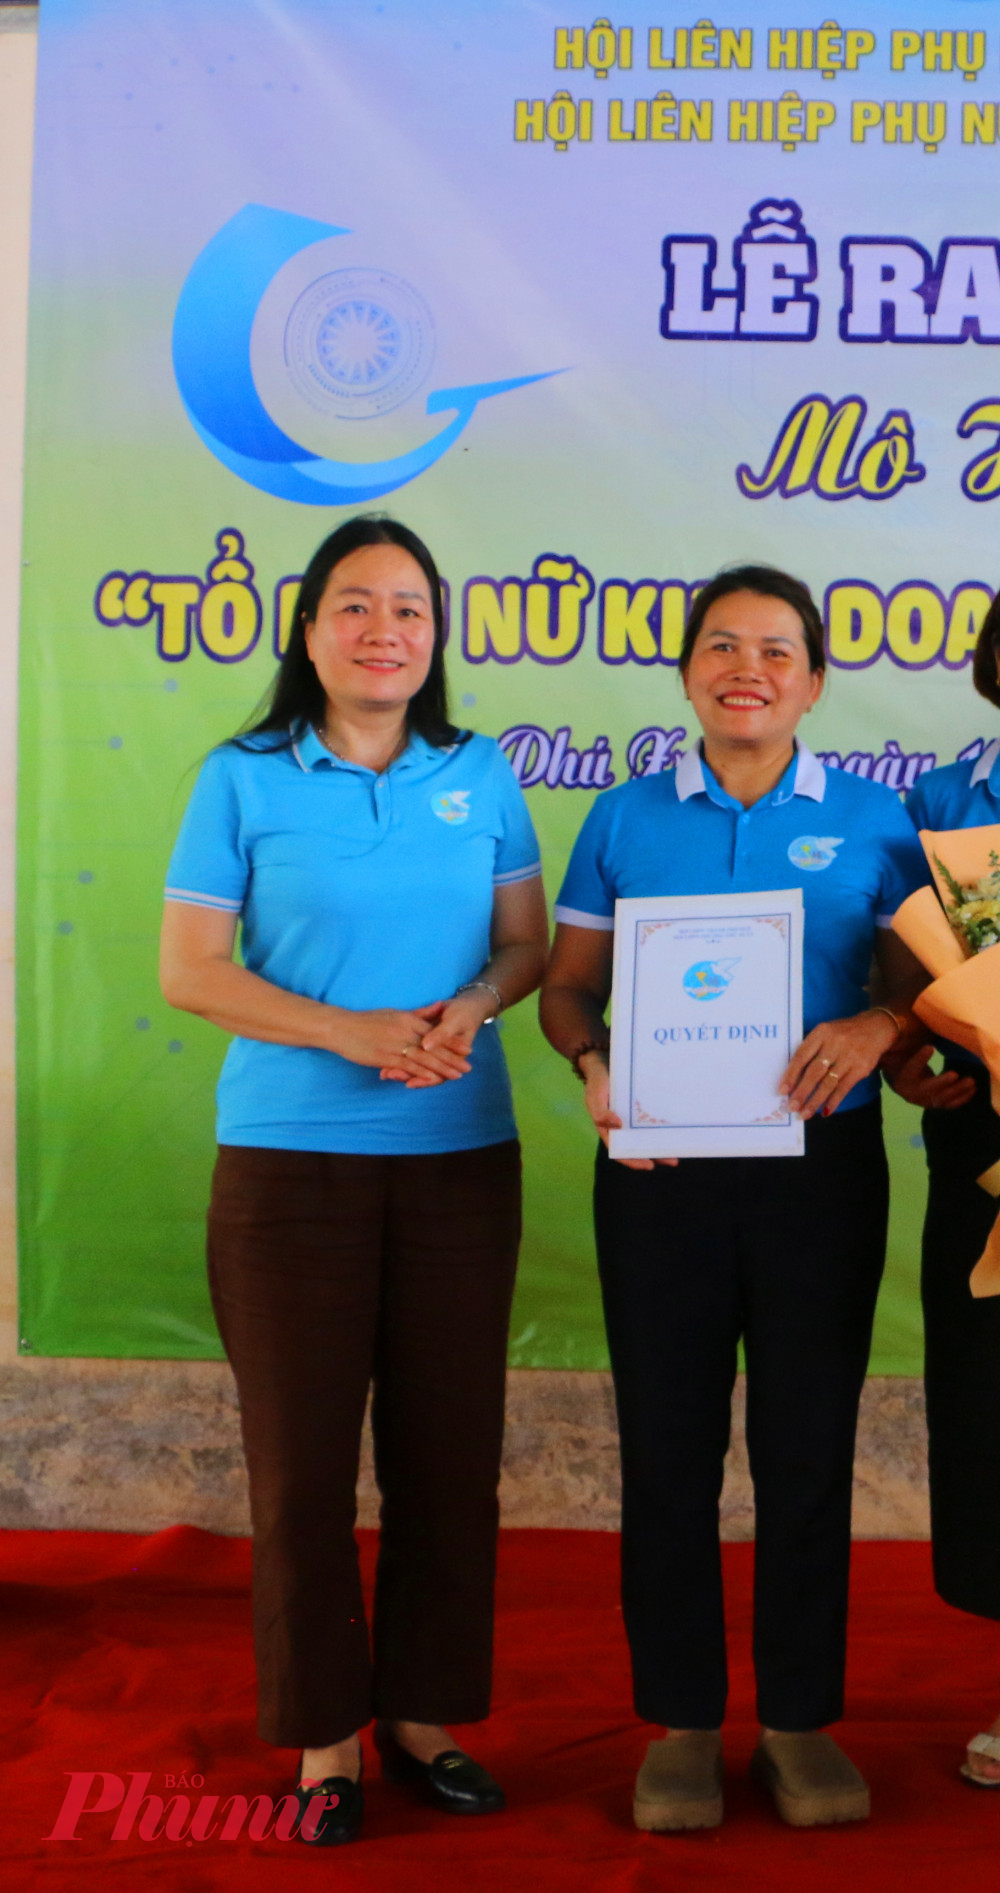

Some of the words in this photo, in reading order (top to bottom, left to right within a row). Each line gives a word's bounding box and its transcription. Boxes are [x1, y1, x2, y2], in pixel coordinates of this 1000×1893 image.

[555, 18, 632, 79] HỘI
[648, 19, 752, 69] LIÊN
[768, 20, 875, 79] HIỆP
[891, 29, 986, 81] PHỤ
[514, 90, 593, 151] HỘI
[608, 90, 713, 142] LIÊN
[727, 90, 836, 151] HIỆP
[851, 101, 946, 153] PHỤ
[660, 197, 819, 342] LỄ
[736, 393, 926, 501] Mô
[463, 552, 595, 665] NỮ
[653, 1022, 723, 1044] QUYẾT
[728, 1024, 778, 1043] ĐỊNH
